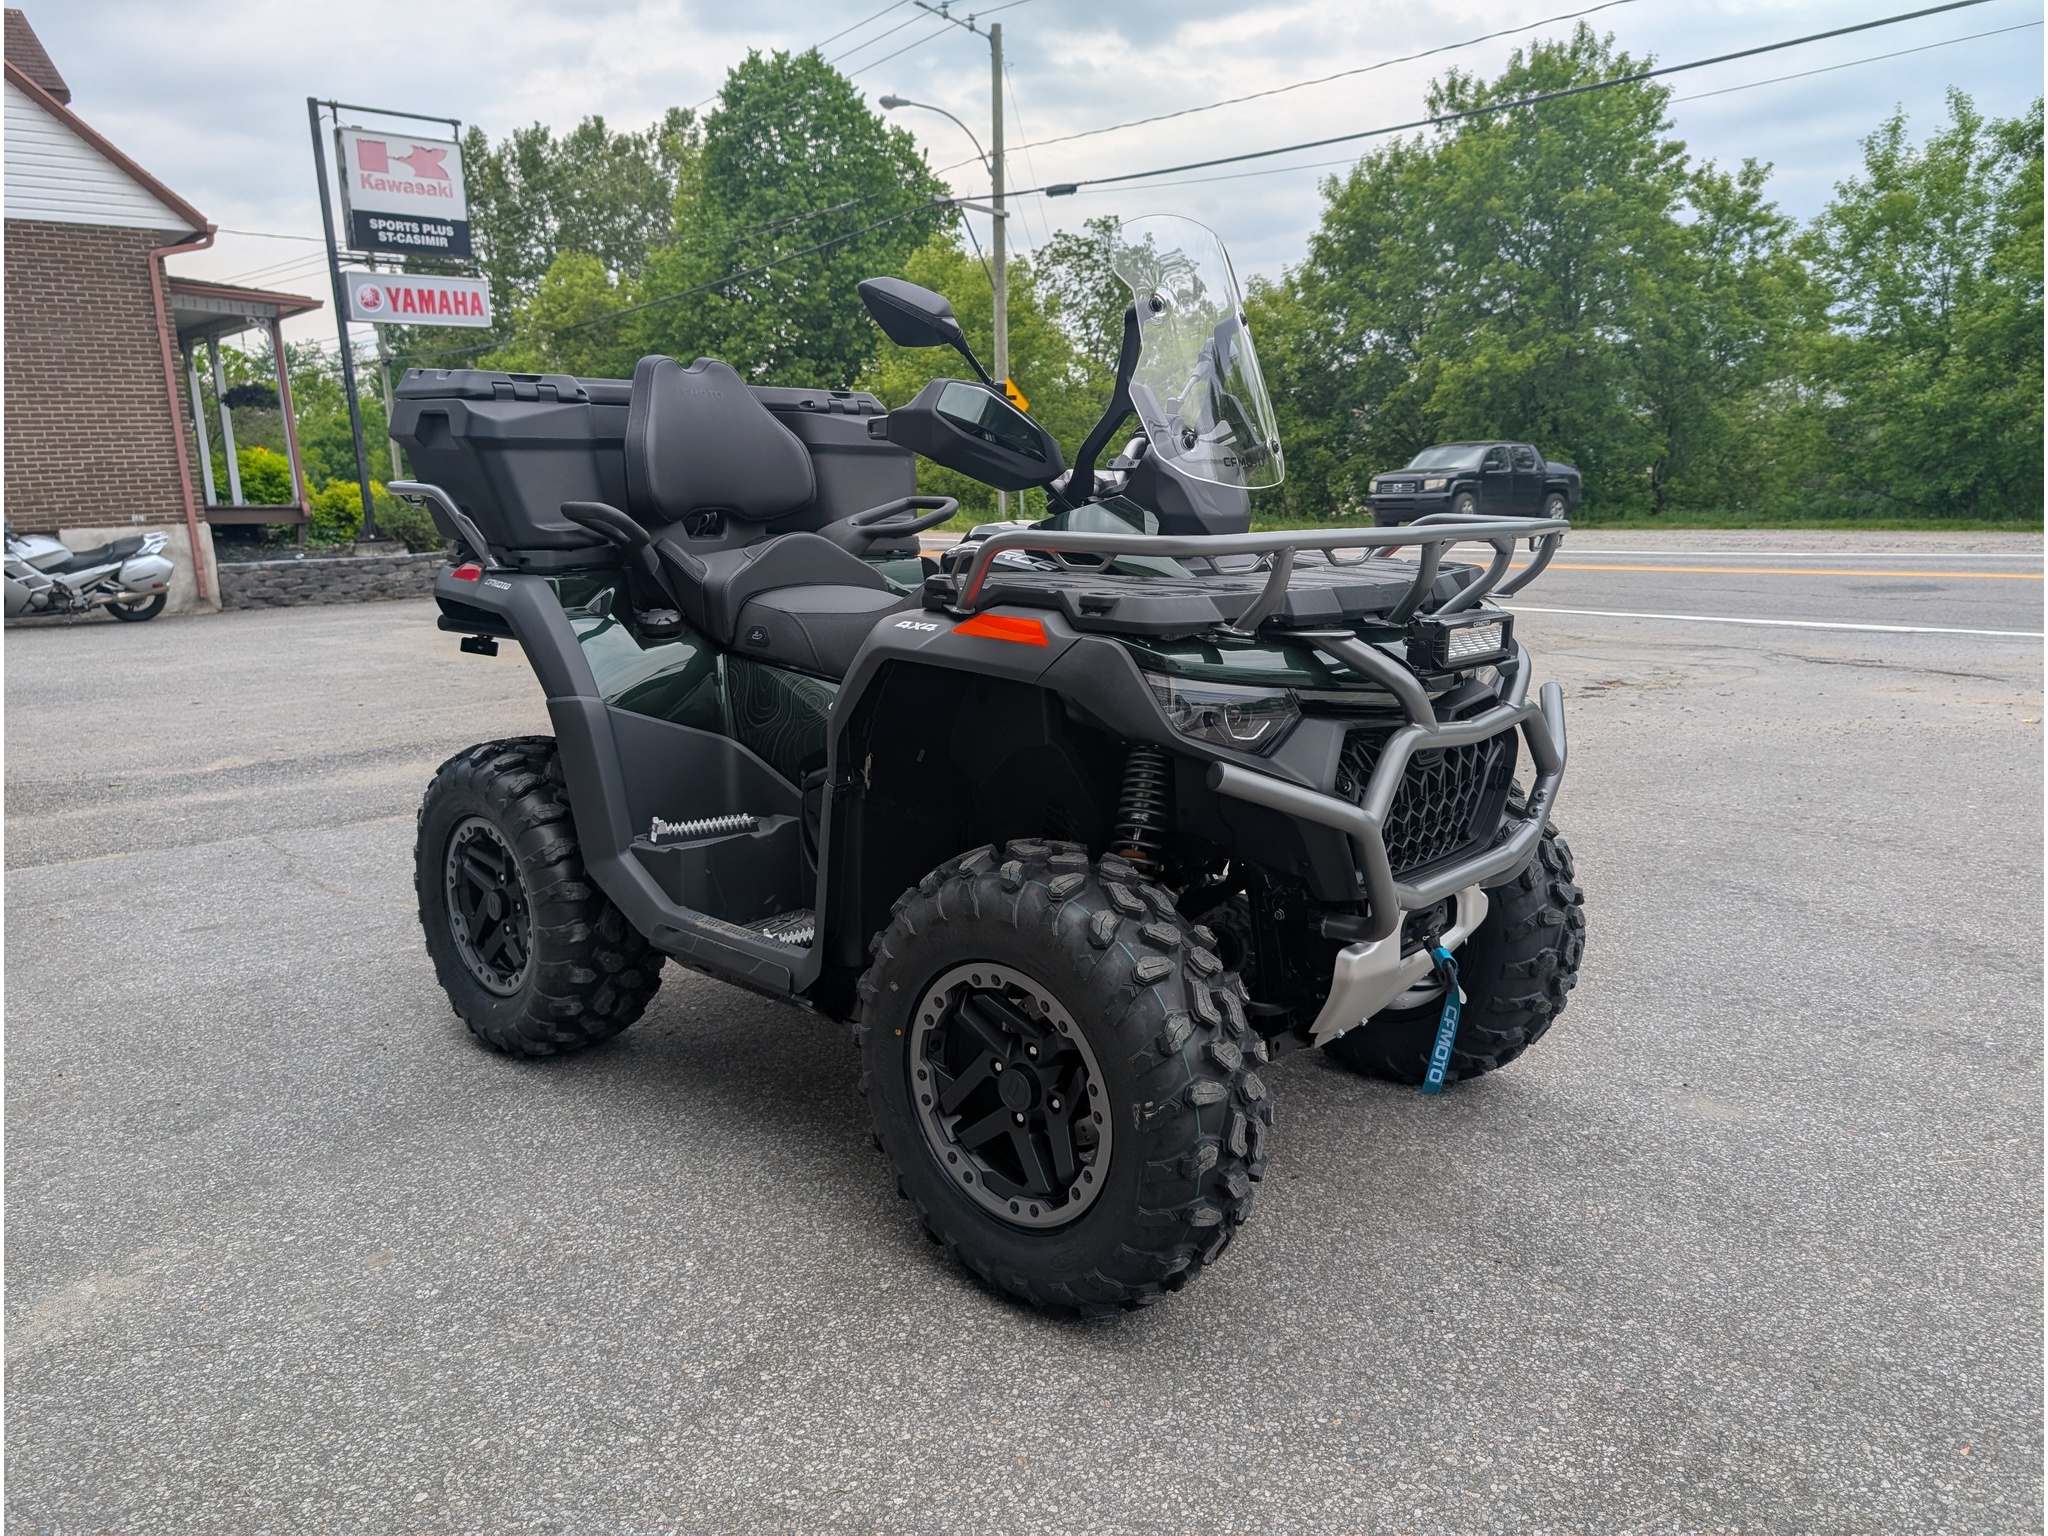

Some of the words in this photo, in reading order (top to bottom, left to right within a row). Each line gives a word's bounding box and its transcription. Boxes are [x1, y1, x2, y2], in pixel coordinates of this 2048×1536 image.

[360, 172, 454, 199] Kawasaki
[369, 217, 420, 234] SPORTS
[421, 222, 455, 237] PLUS
[378, 230, 449, 248] ST-CASIMIR
[385, 286, 485, 317] YAMAHA
[1223, 456, 1266, 468] CFMO
[484, 578, 512, 590] CFMOTO
[1428, 1004, 1458, 1084] CFMOTO
